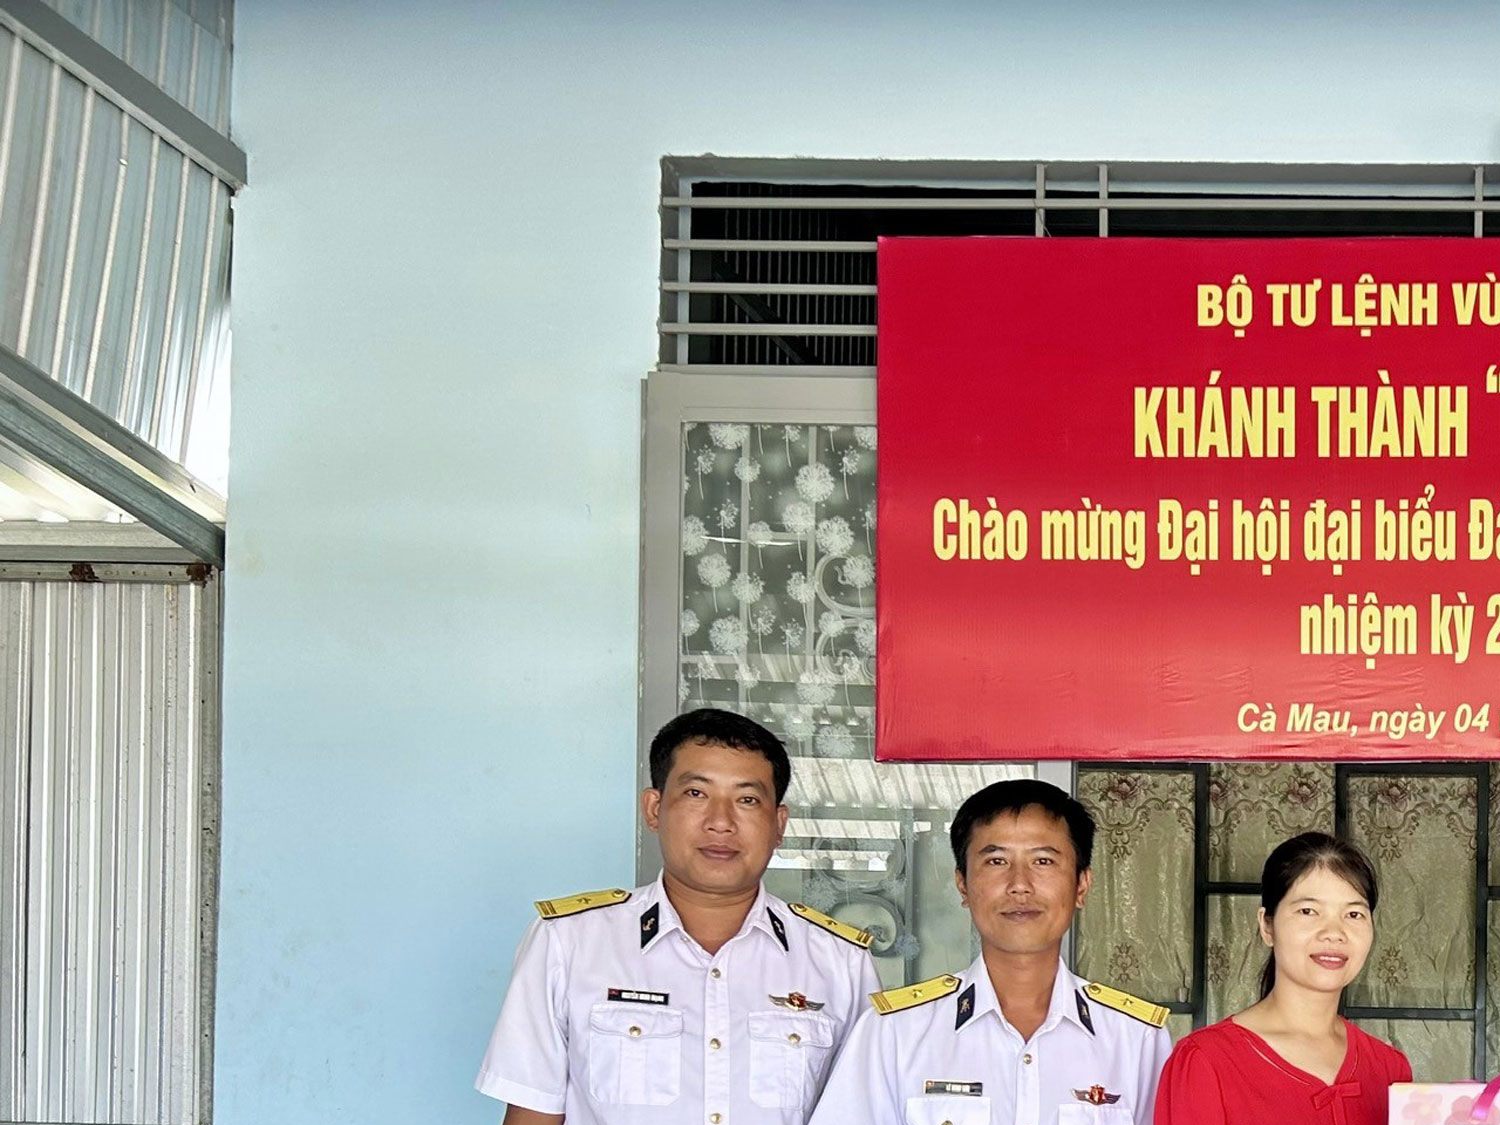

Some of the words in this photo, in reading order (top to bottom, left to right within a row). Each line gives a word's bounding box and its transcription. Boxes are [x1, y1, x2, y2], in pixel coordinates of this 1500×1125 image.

[1198, 275, 1252, 337] BỘ
[1267, 279, 1321, 326] TƯ
[1332, 275, 1437, 336] LỆNH
[1135, 371, 1295, 457] KHÁNH
[1312, 371, 1467, 457] THÀNH
[934, 498, 1027, 560] Chào
[1042, 498, 1145, 569] mừng
[1158, 500, 1218, 575] Đại
[1233, 498, 1289, 575] hội
[1304, 500, 1360, 575] đại
[1376, 485, 1455, 561] biểu
[1301, 593, 1417, 669] nhiệm
[1431, 593, 1474, 663] kỳ
[1238, 703, 1276, 732] Cà
[1287, 704, 1358, 736] Mau,
[1368, 704, 1446, 740] ngày
[1454, 703, 1489, 732] 04
